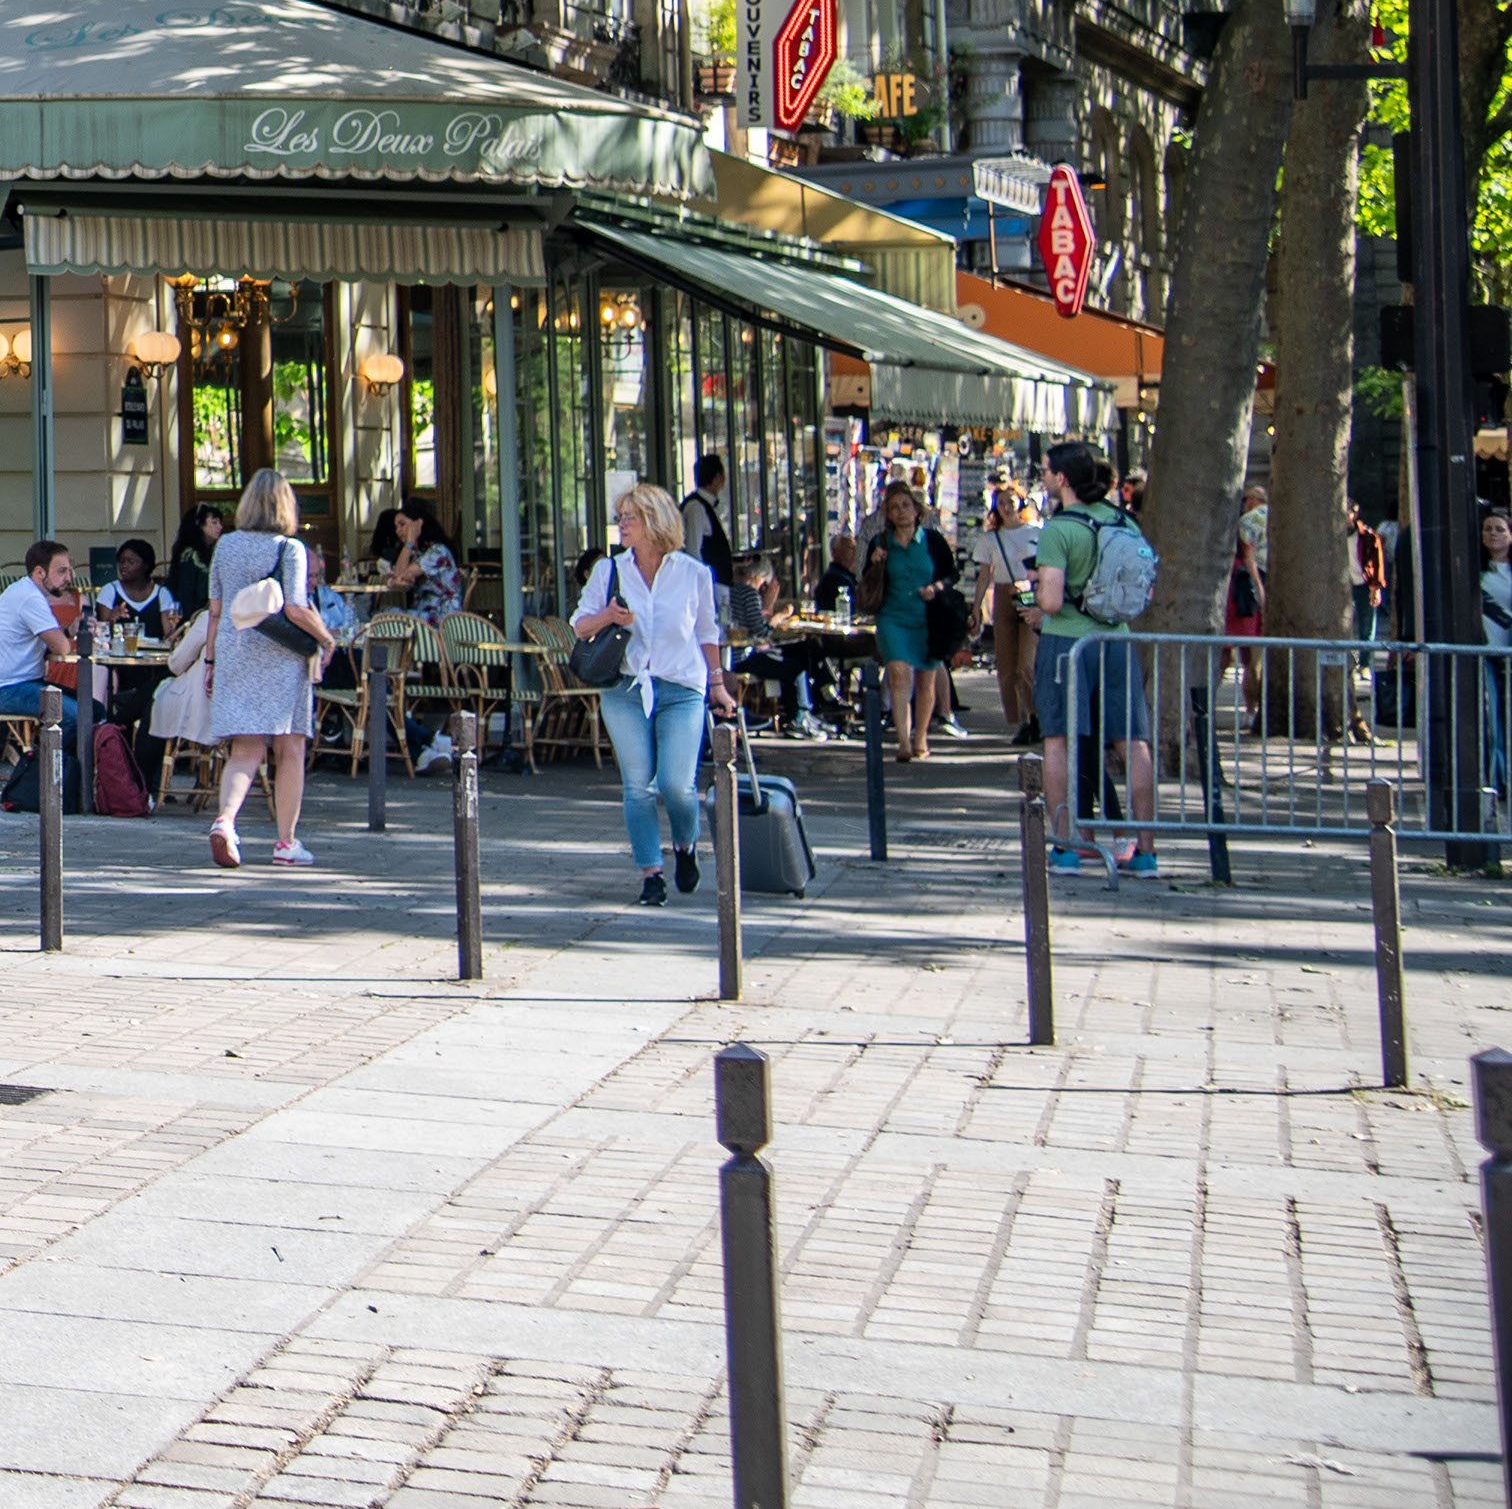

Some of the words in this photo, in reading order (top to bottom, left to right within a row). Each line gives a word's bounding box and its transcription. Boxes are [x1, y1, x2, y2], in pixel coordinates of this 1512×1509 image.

[790, 8, 820, 90] TABAC
[872, 73, 919, 119] AFE
[243, 107, 319, 156] Les
[329, 109, 434, 155] Deux
[443, 112, 543, 160] Palais
[1051, 179, 1076, 304] TABAC
